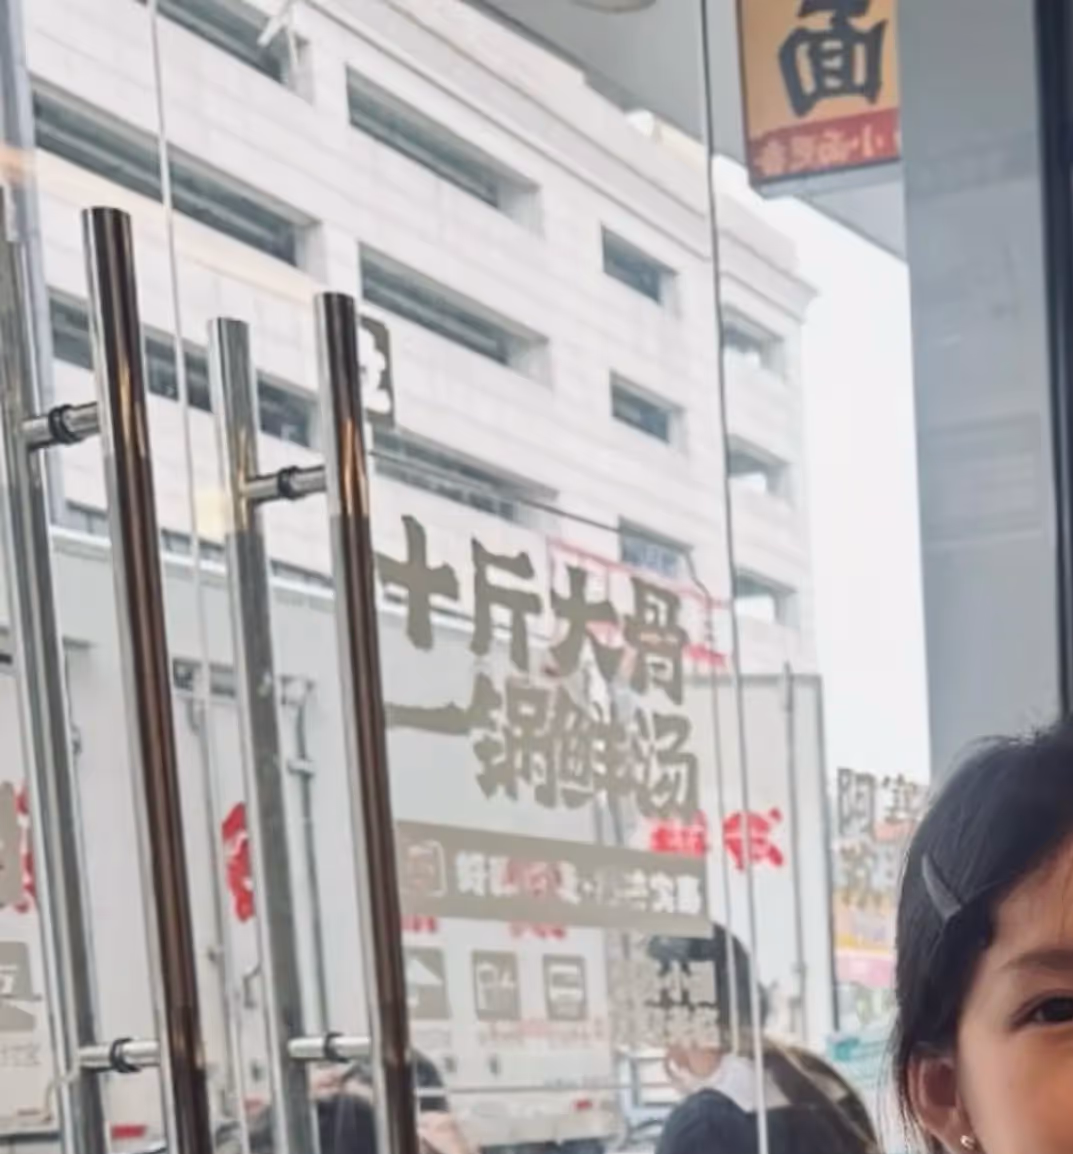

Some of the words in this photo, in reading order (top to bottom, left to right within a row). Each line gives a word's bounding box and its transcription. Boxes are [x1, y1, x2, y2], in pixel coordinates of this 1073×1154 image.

[374, 514, 691, 705] 十斤大骨
[384, 674, 699, 820] 一锅鲜汤
